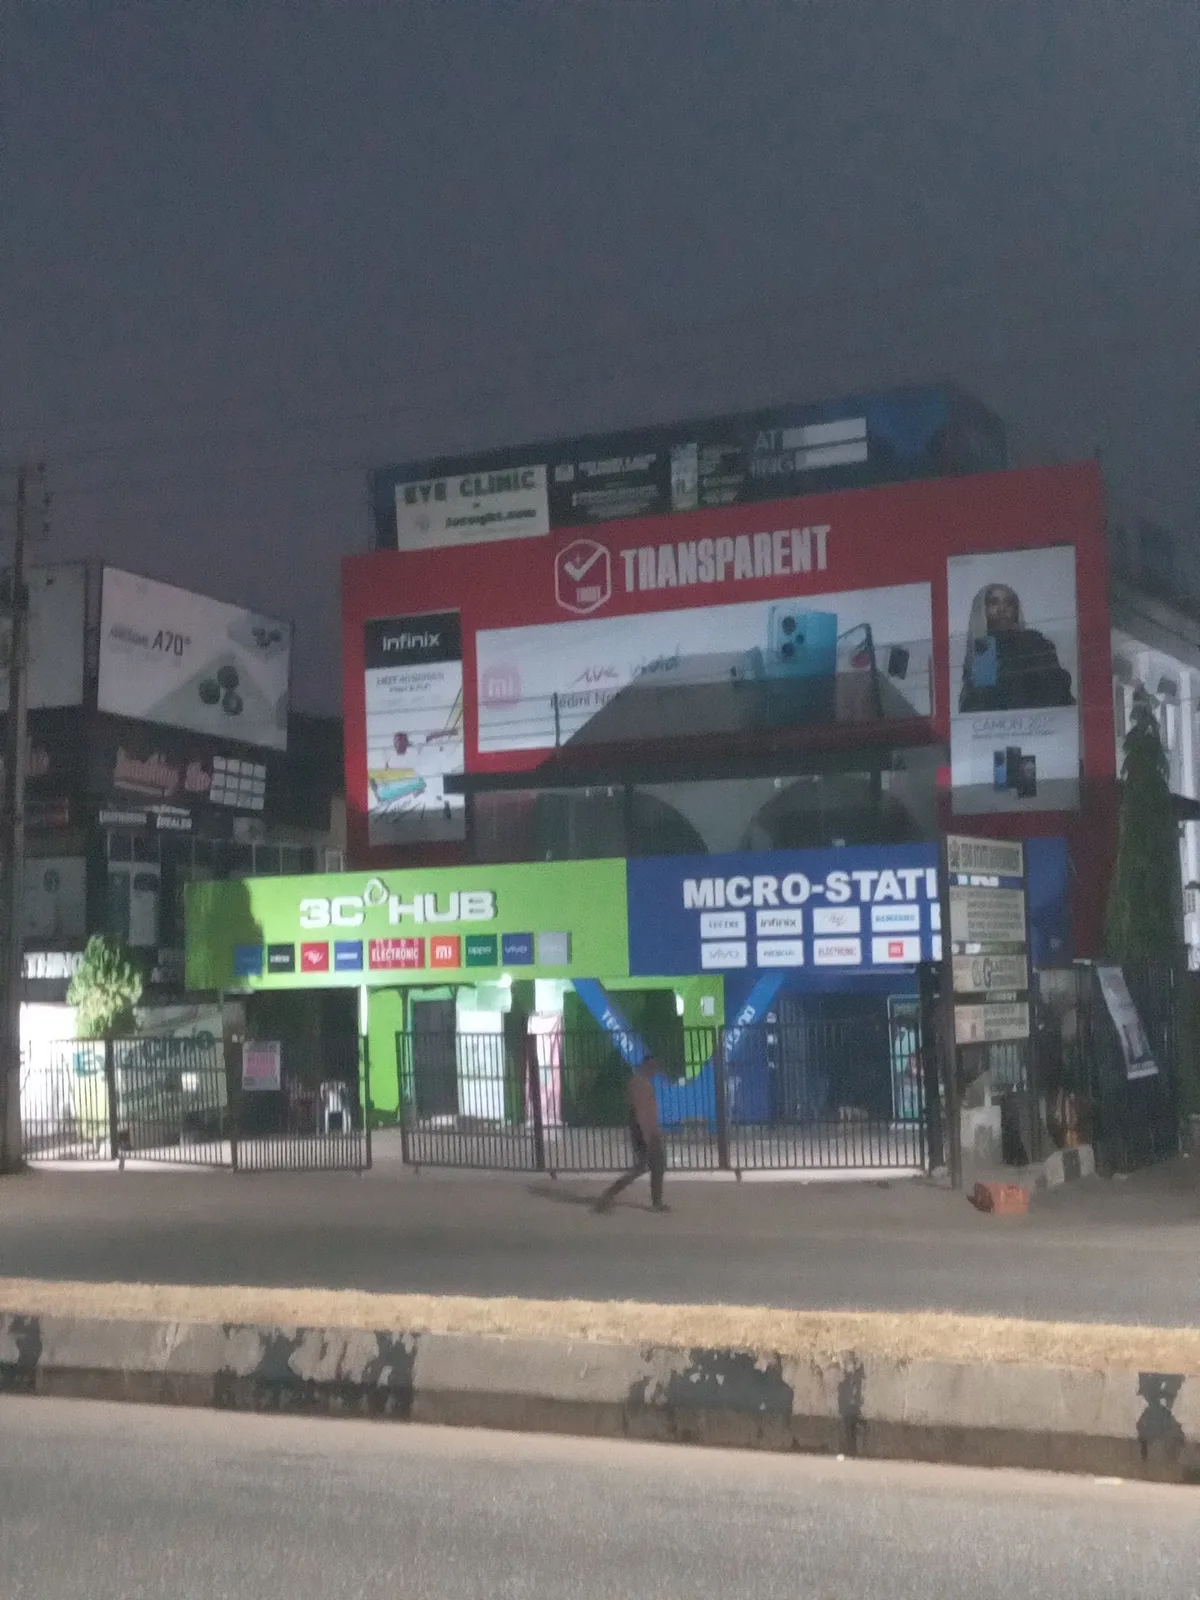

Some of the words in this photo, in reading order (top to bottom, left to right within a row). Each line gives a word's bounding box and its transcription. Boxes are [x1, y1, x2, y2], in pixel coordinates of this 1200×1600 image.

[459, 470, 535, 497] CLINIC
[620, 525, 831, 592] TRANSPARENT
[300, 896, 366, 929] 3C
[388, 891, 496, 925] HUB
[371, 946, 420, 962] ELECTRONIC
